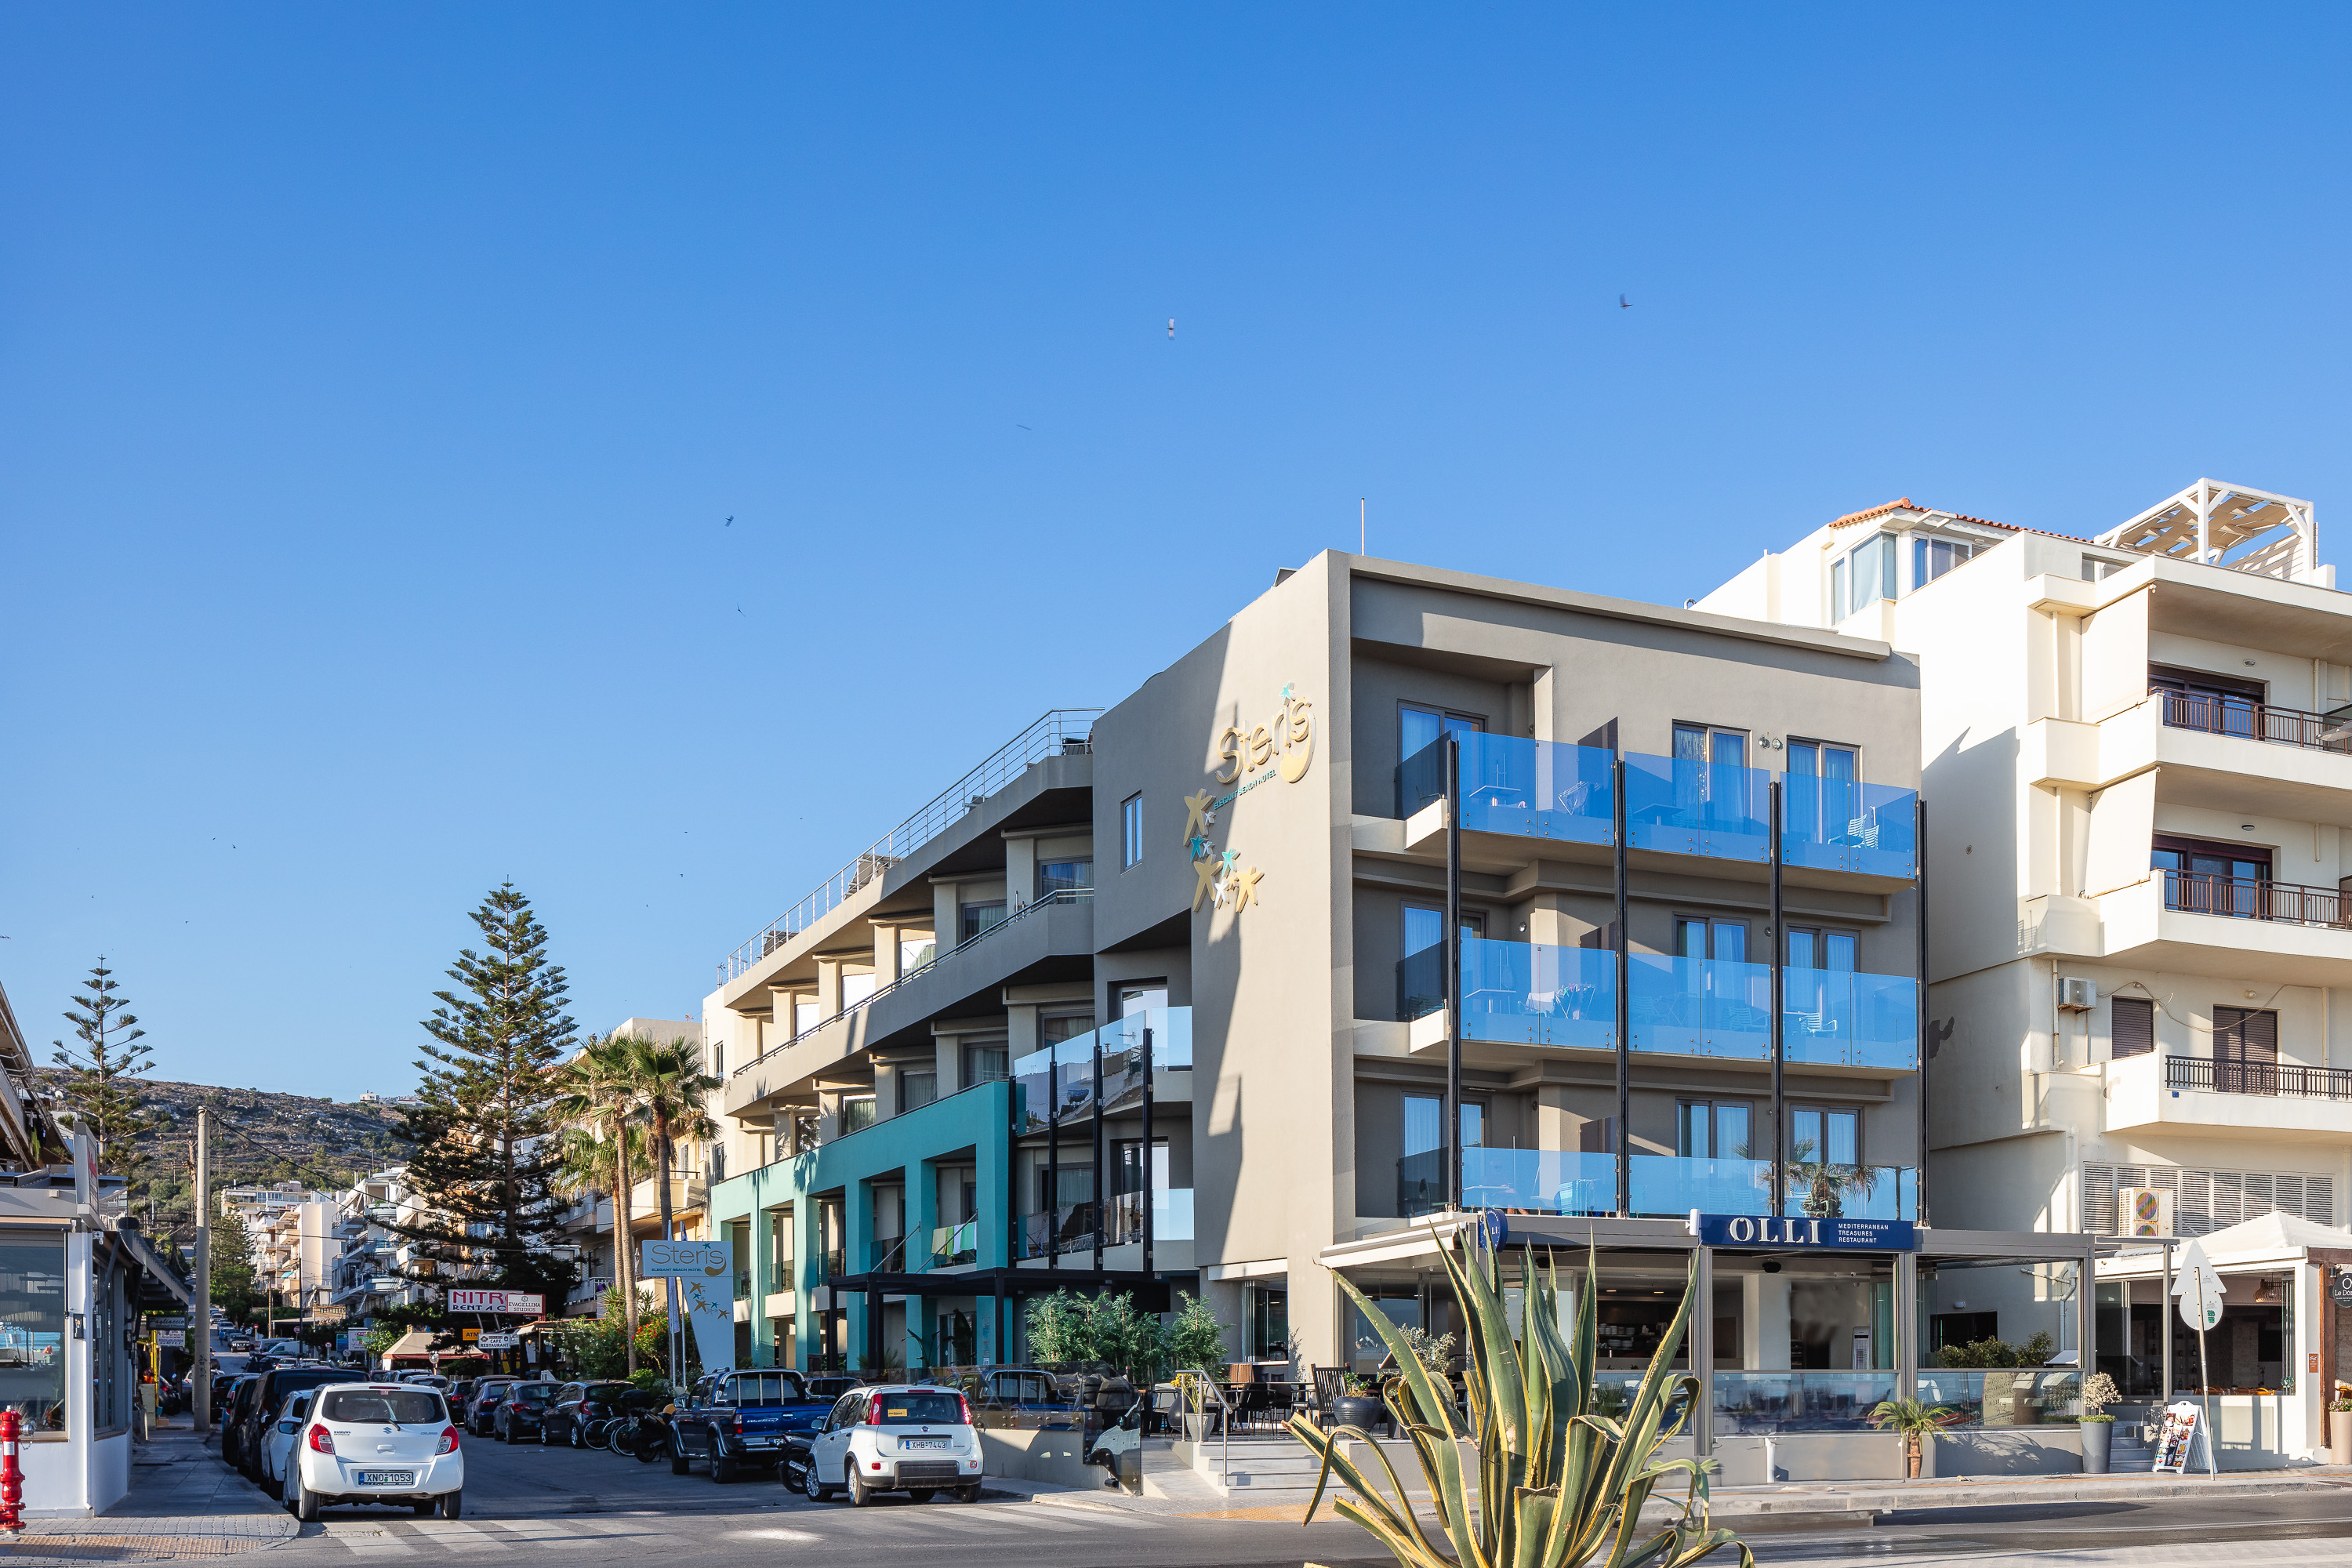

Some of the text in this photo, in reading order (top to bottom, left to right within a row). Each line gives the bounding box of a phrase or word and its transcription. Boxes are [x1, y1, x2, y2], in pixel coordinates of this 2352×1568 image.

[1215, 690, 1315, 784] Steris
[1213, 769, 1276, 810] ELEGANT BEACH HOTEL
[1729, 1217, 1821, 1244] OLLI
[651, 1243, 724, 1265] Steris
[452, 1291, 517, 1304] NITR
